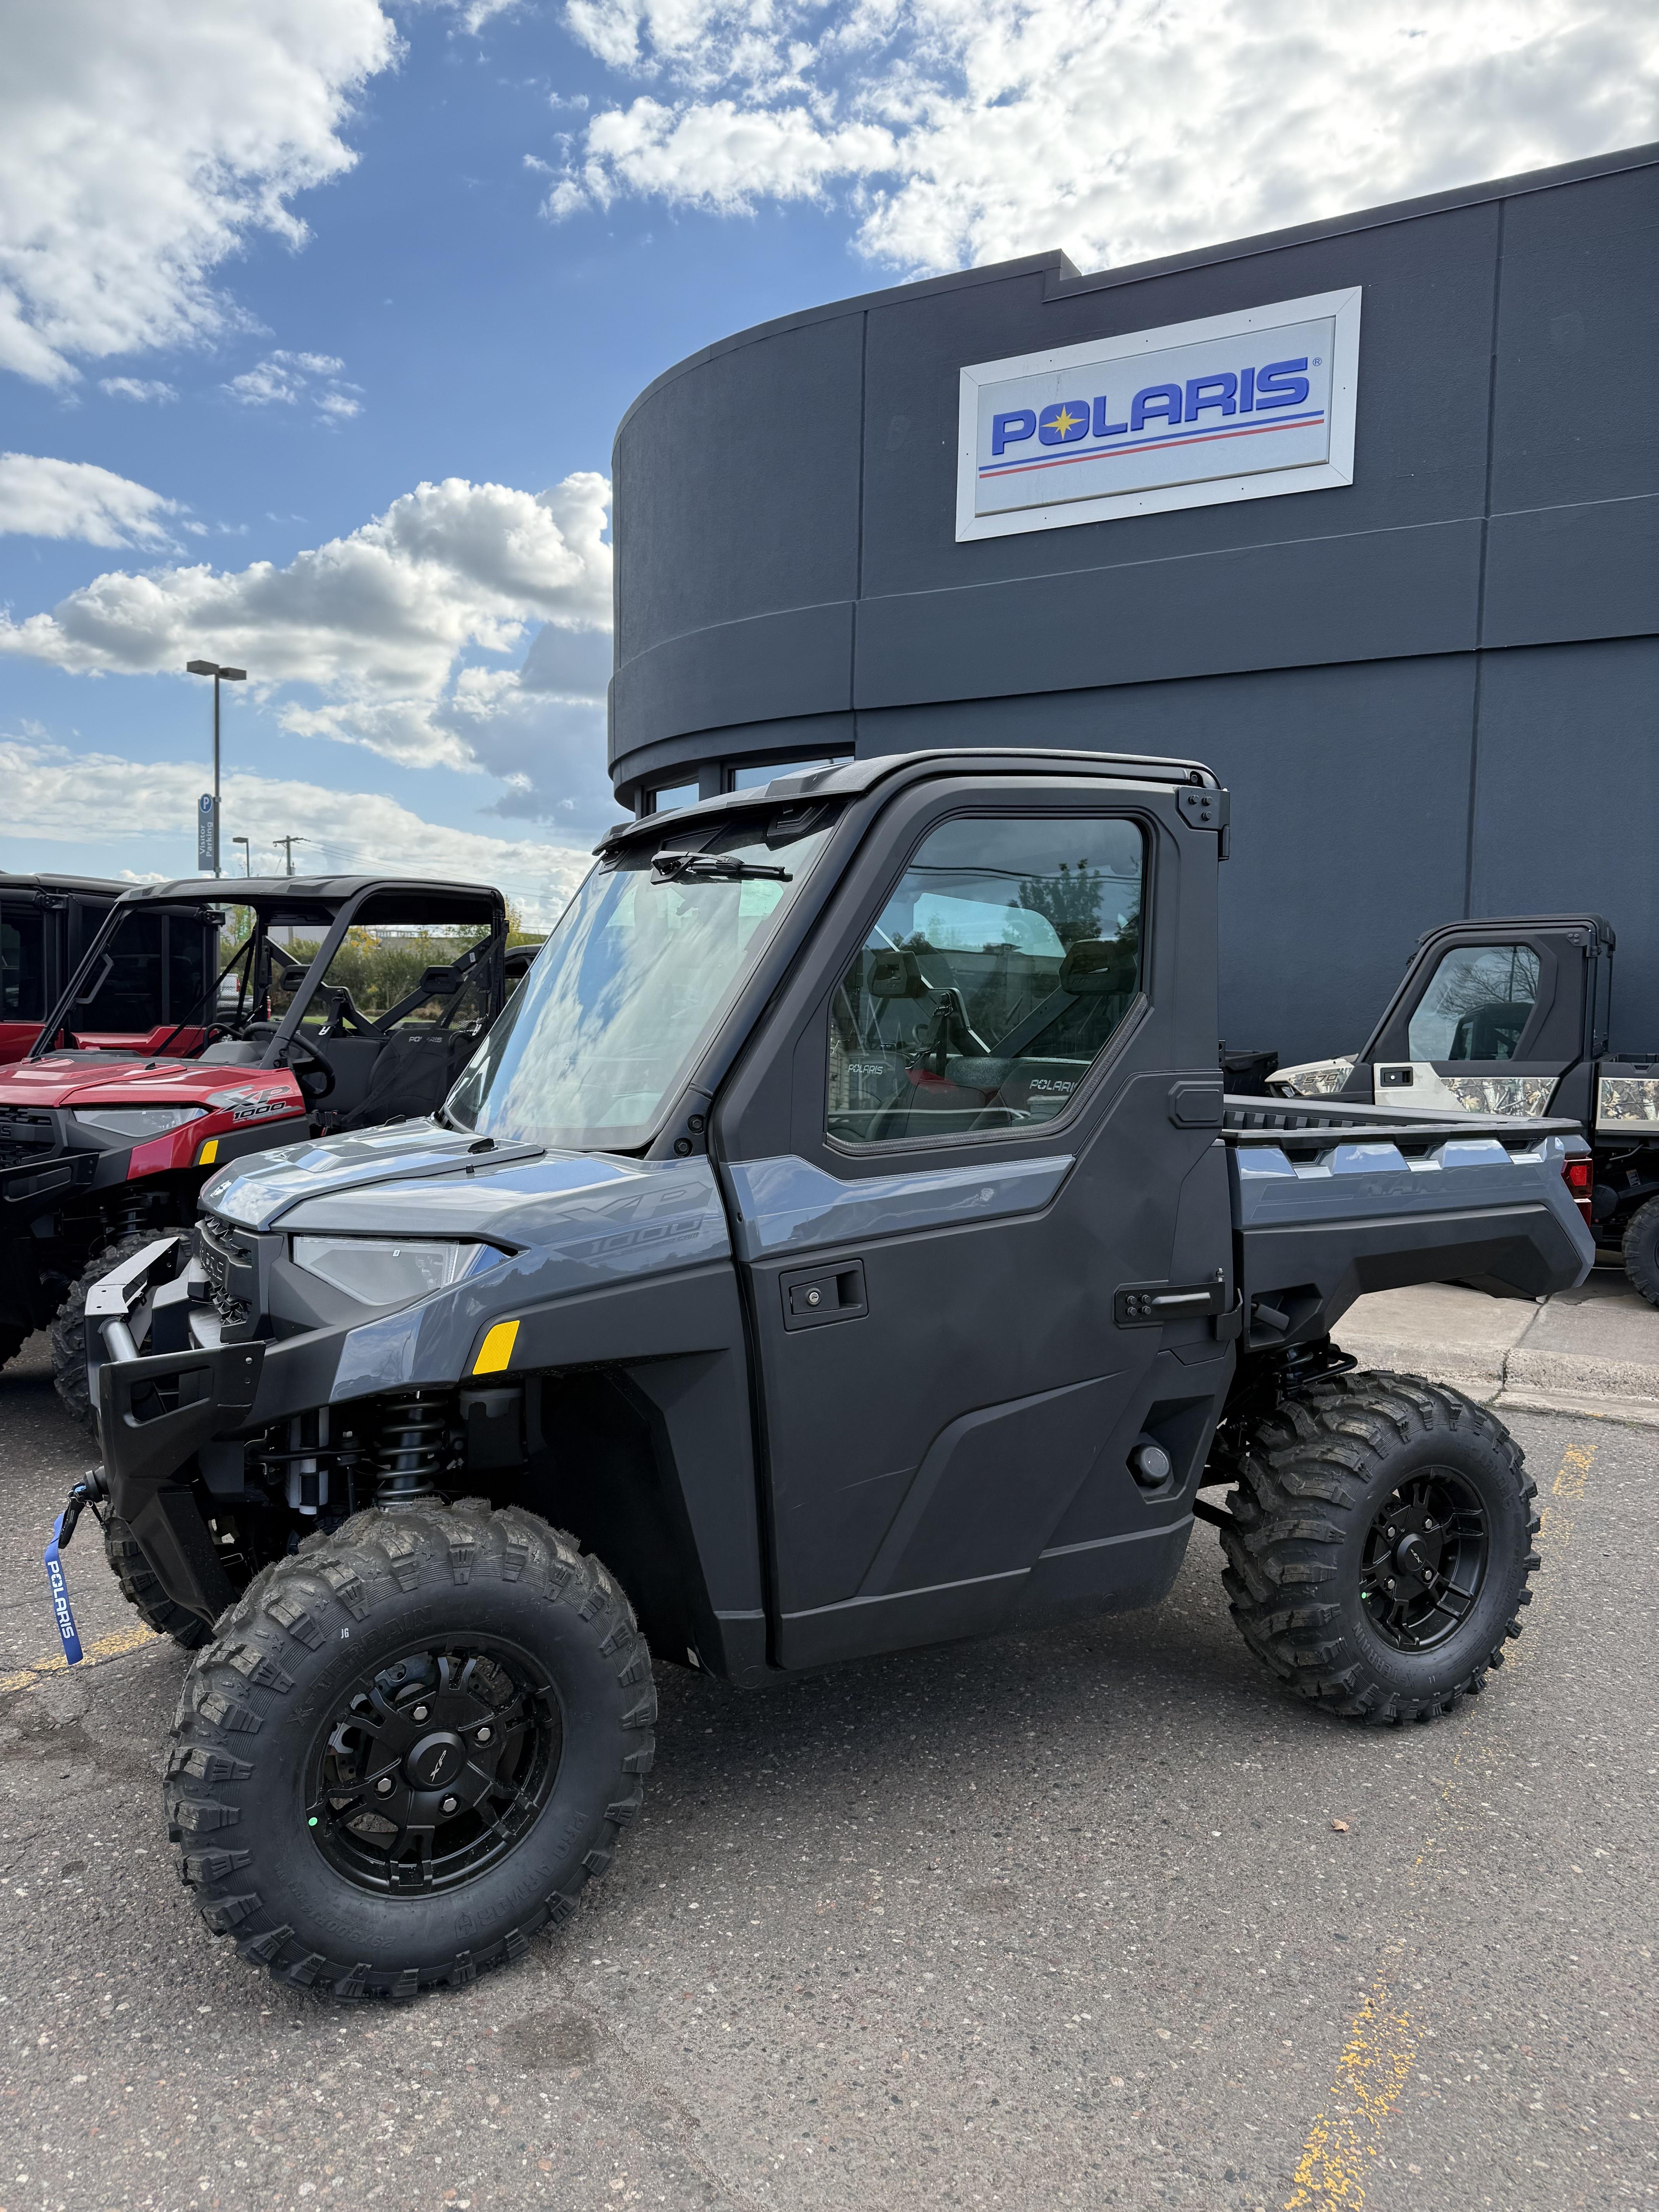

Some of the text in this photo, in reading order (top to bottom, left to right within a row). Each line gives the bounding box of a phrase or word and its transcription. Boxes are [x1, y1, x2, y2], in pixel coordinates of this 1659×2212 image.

[203, 797, 210, 810] P
[848, 1064, 883, 1075] POLARIS
[220, 1085, 292, 1113] XP
[233, 1101, 286, 1121] 1000
[538, 1180, 714, 1242] XP
[590, 1214, 704, 1255] 1000
[47, 1560, 74, 1639] POLARIS
[340, 1627, 349, 1639] JG
[286, 1605, 433, 1727] X-TERRAIN
[430, 1750, 447, 1782] XP
[477, 1861, 555, 1926] ARMOR
